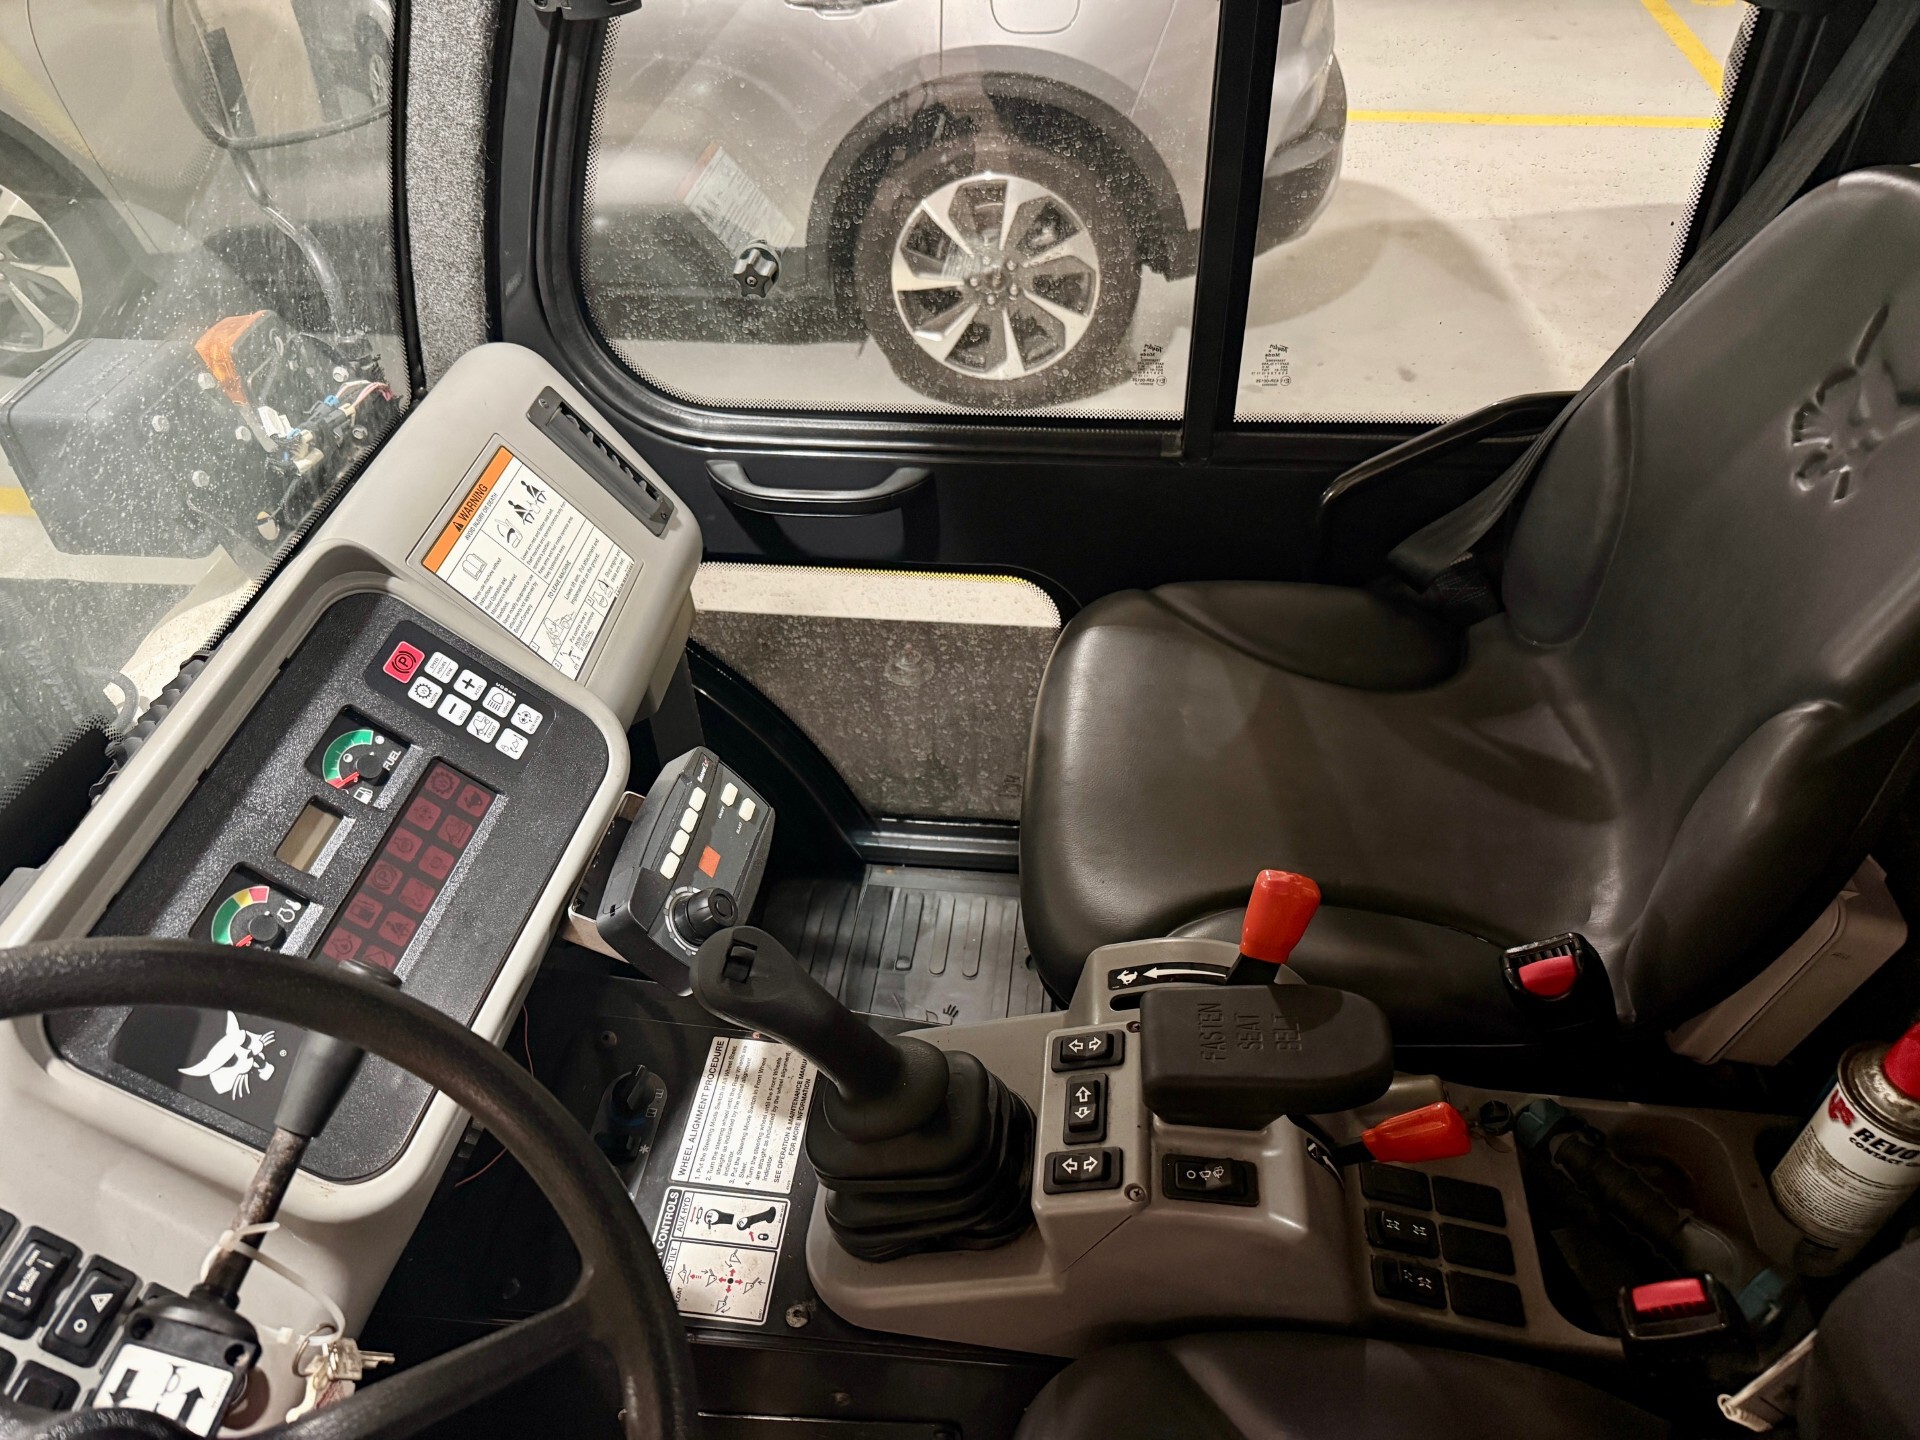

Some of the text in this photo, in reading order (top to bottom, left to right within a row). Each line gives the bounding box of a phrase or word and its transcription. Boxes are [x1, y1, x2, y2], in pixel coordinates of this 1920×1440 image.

[458, 482, 488, 522] WARNING
[464, 491, 498, 541] AVOID INJURY OR DEATH
[547, 559, 571, 599] TO LEAVE MACHINE
[398, 656, 410, 668] P
[435, 660, 447, 675] HOURS
[501, 699, 512, 714] LIGHTS
[382, 750, 402, 770] FUEL
[1198, 1002, 1226, 1063] FASTEN
[1236, 1012, 1264, 1050] SEAT
[1272, 1014, 1302, 1051] BELT
[798, 1058, 808, 1079] MANU
[677, 1040, 724, 1176] WHEEL ALIGNMENT PROCEDURE
[787, 1080, 803, 1124] MAINTENANCE
[787, 1078, 811, 1155] FOR MORE INFORMATION
[776, 1131, 791, 1168] OPERATION
[1849, 1137, 1903, 1165] CONTACT
[773, 1169, 781, 1183] SEE
[655, 1191, 680, 1249] CONTROLS
[675, 1196, 691, 1232] AUX HYD
[667, 1246, 678, 1263] TILT
[673, 1286, 683, 1305] LOAT
